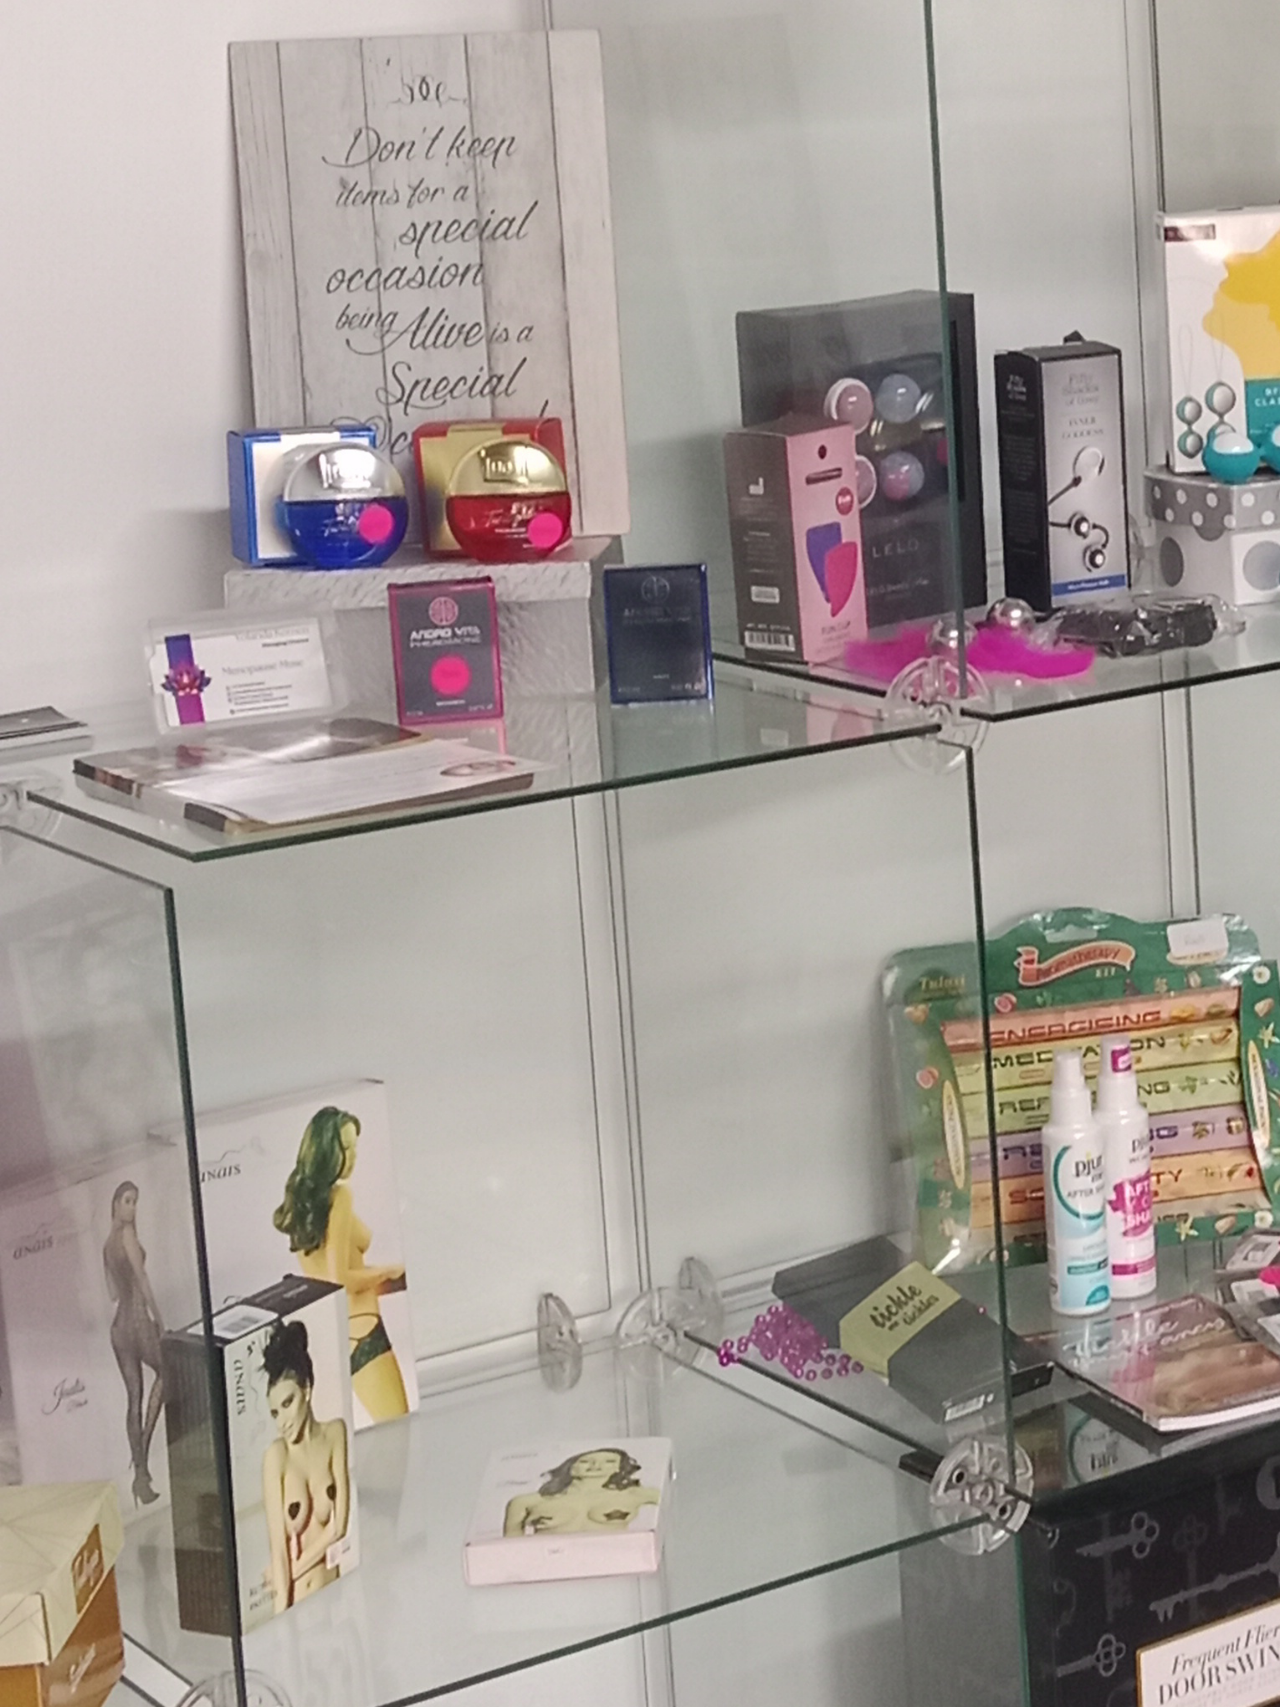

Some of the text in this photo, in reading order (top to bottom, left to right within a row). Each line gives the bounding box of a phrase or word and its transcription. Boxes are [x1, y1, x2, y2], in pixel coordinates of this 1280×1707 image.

[321, 125, 517, 168] Don't keep
[335, 177, 470, 209] items for a
[399, 200, 539, 257] special
[326, 257, 485, 294] occasion
[335, 303, 534, 355] being Alive is a
[375, 357, 527, 415] Special
[1172, 1624, 1280, 1676] Frequent Flier
